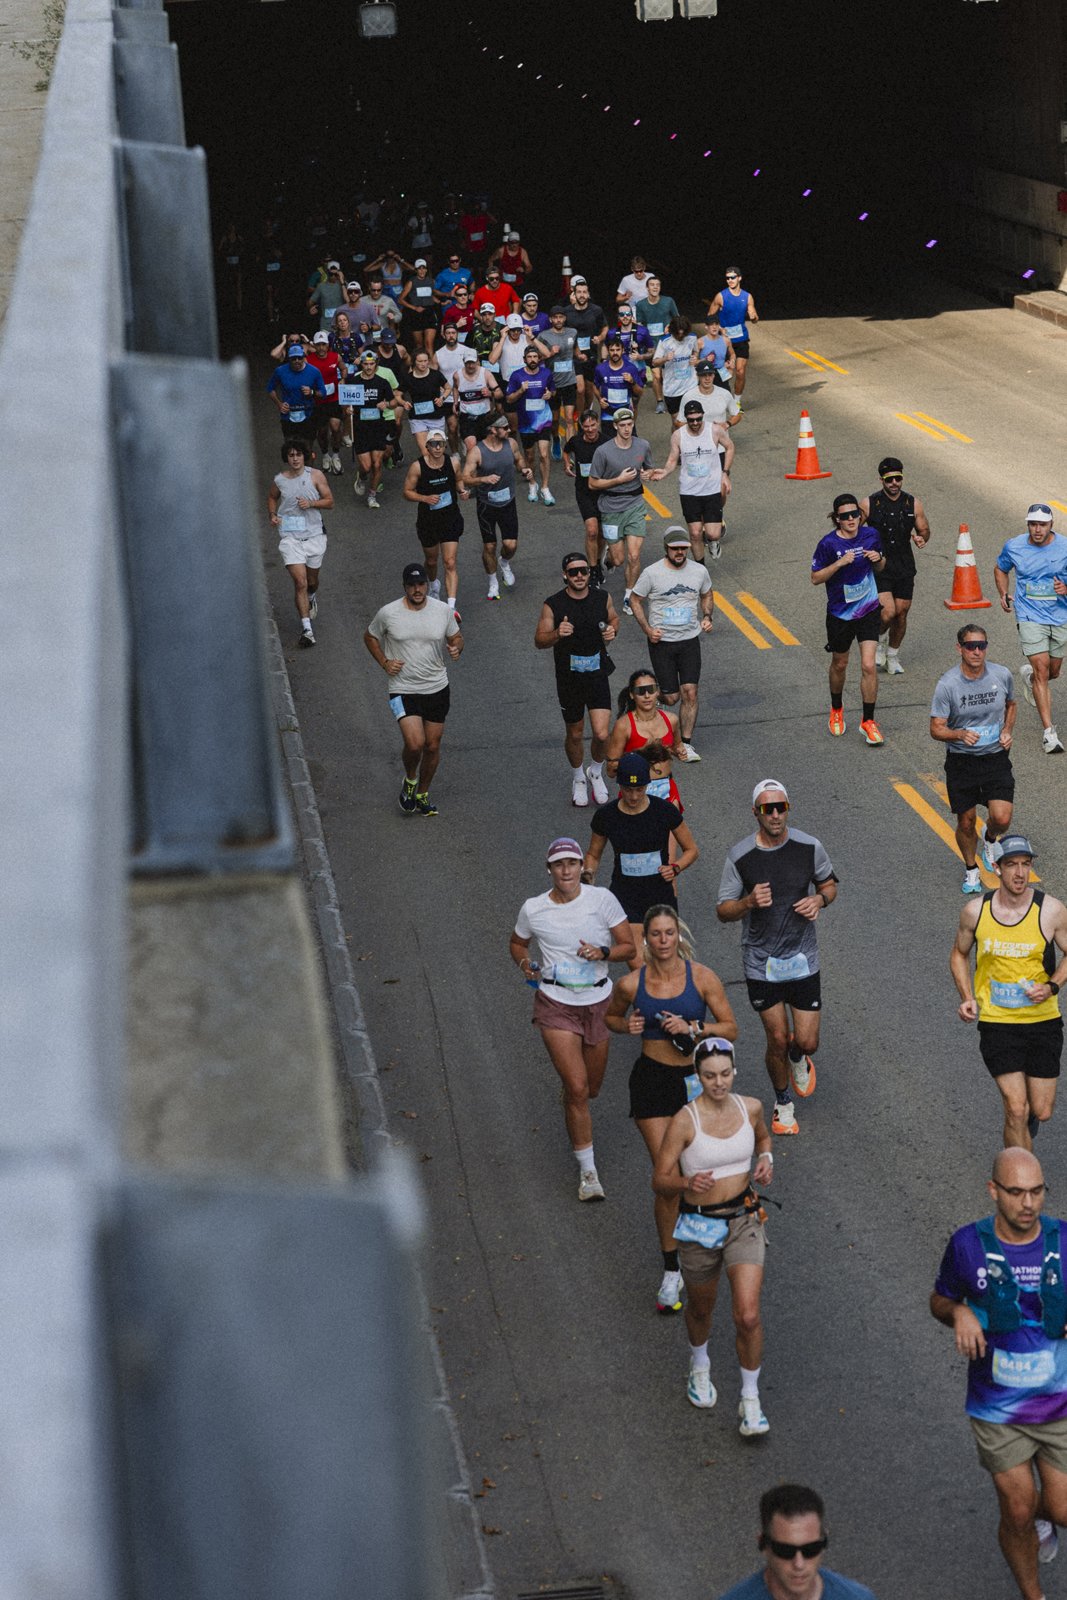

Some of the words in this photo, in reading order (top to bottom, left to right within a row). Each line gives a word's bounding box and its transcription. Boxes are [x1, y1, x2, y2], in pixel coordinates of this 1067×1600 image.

[342, 391, 361, 399] 1H40
[967, 694, 976, 704] le
[976, 690, 999, 703] coureur
[967, 698, 996, 707] nordique
[1002, 941, 1037, 951] coureur
